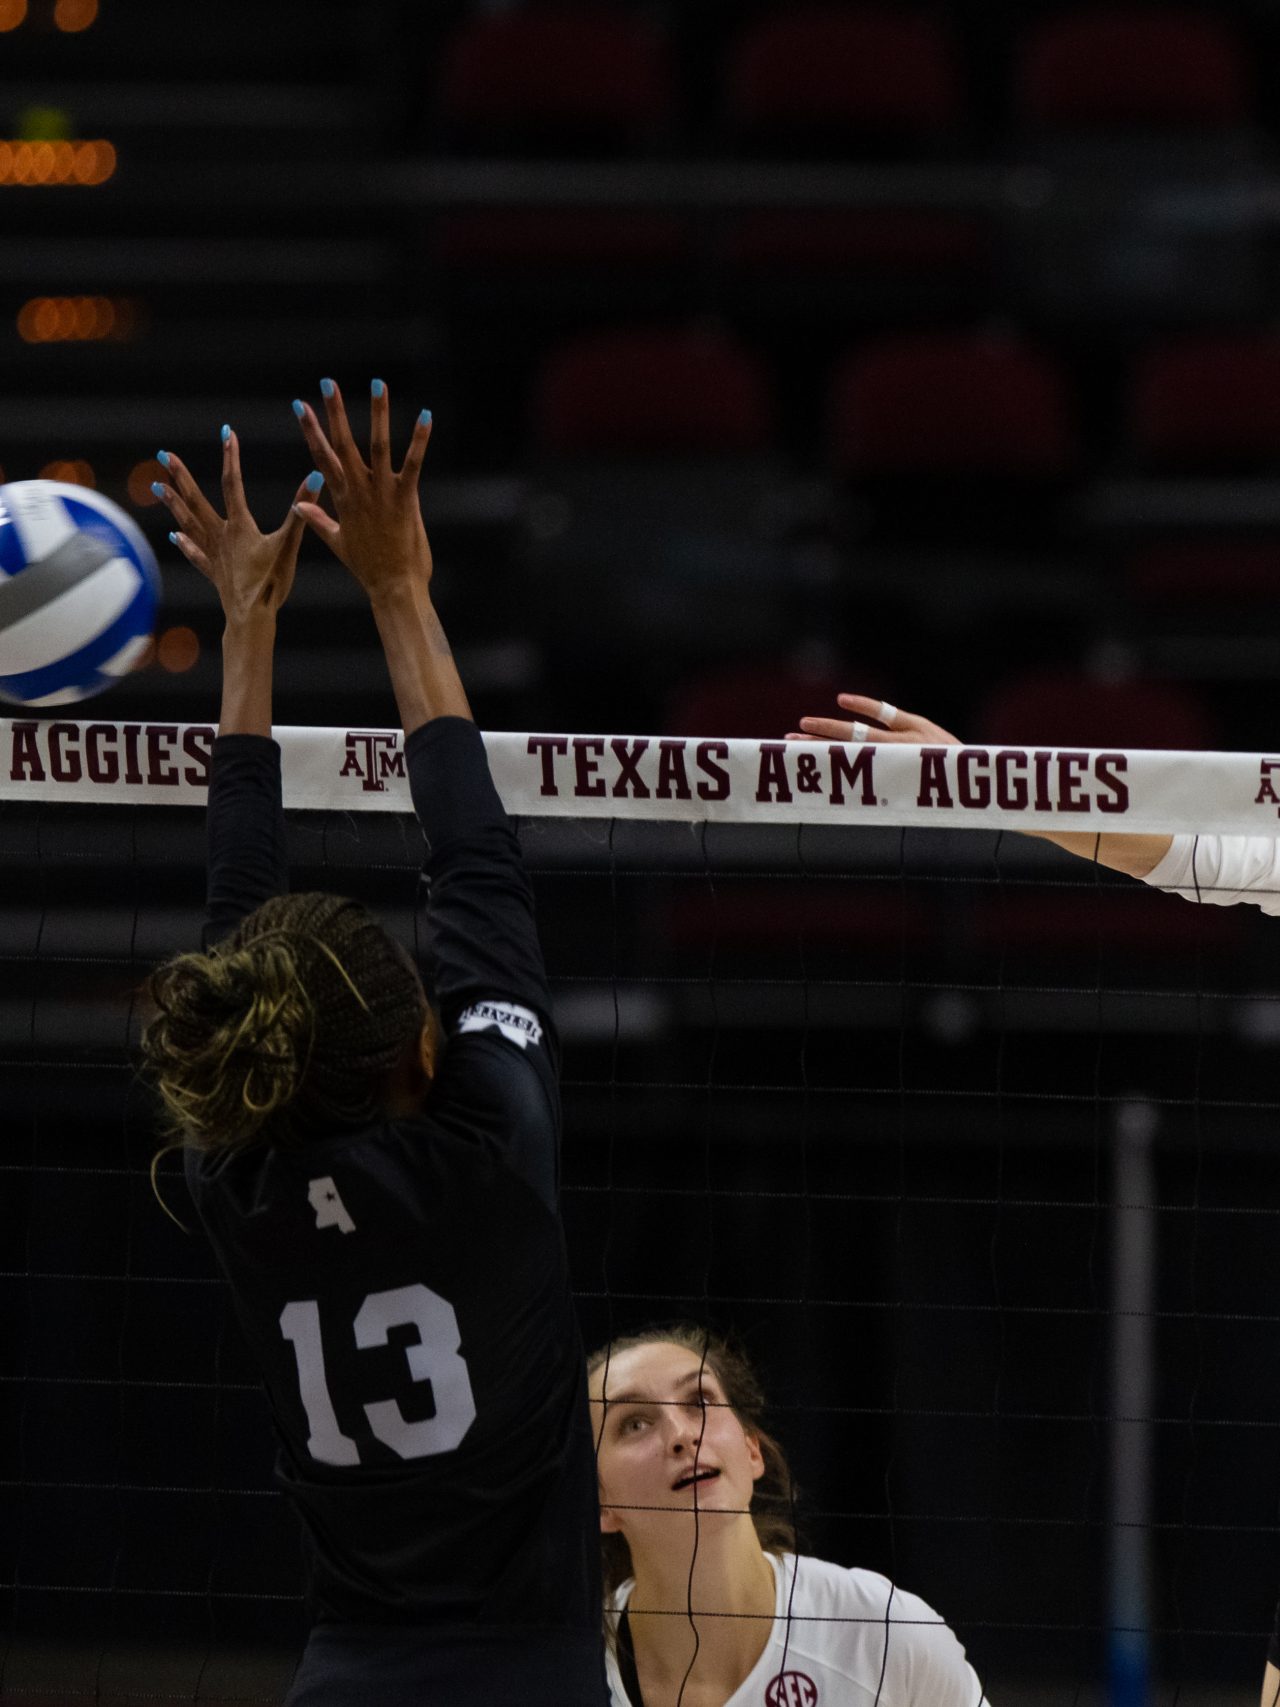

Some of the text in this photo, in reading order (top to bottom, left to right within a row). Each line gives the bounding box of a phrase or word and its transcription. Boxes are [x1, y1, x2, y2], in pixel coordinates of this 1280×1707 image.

[10, 722, 215, 787] AGGIES
[527, 737, 1130, 814] TEXAS A&M AGGIES
[279, 1284, 477, 1466] 13
